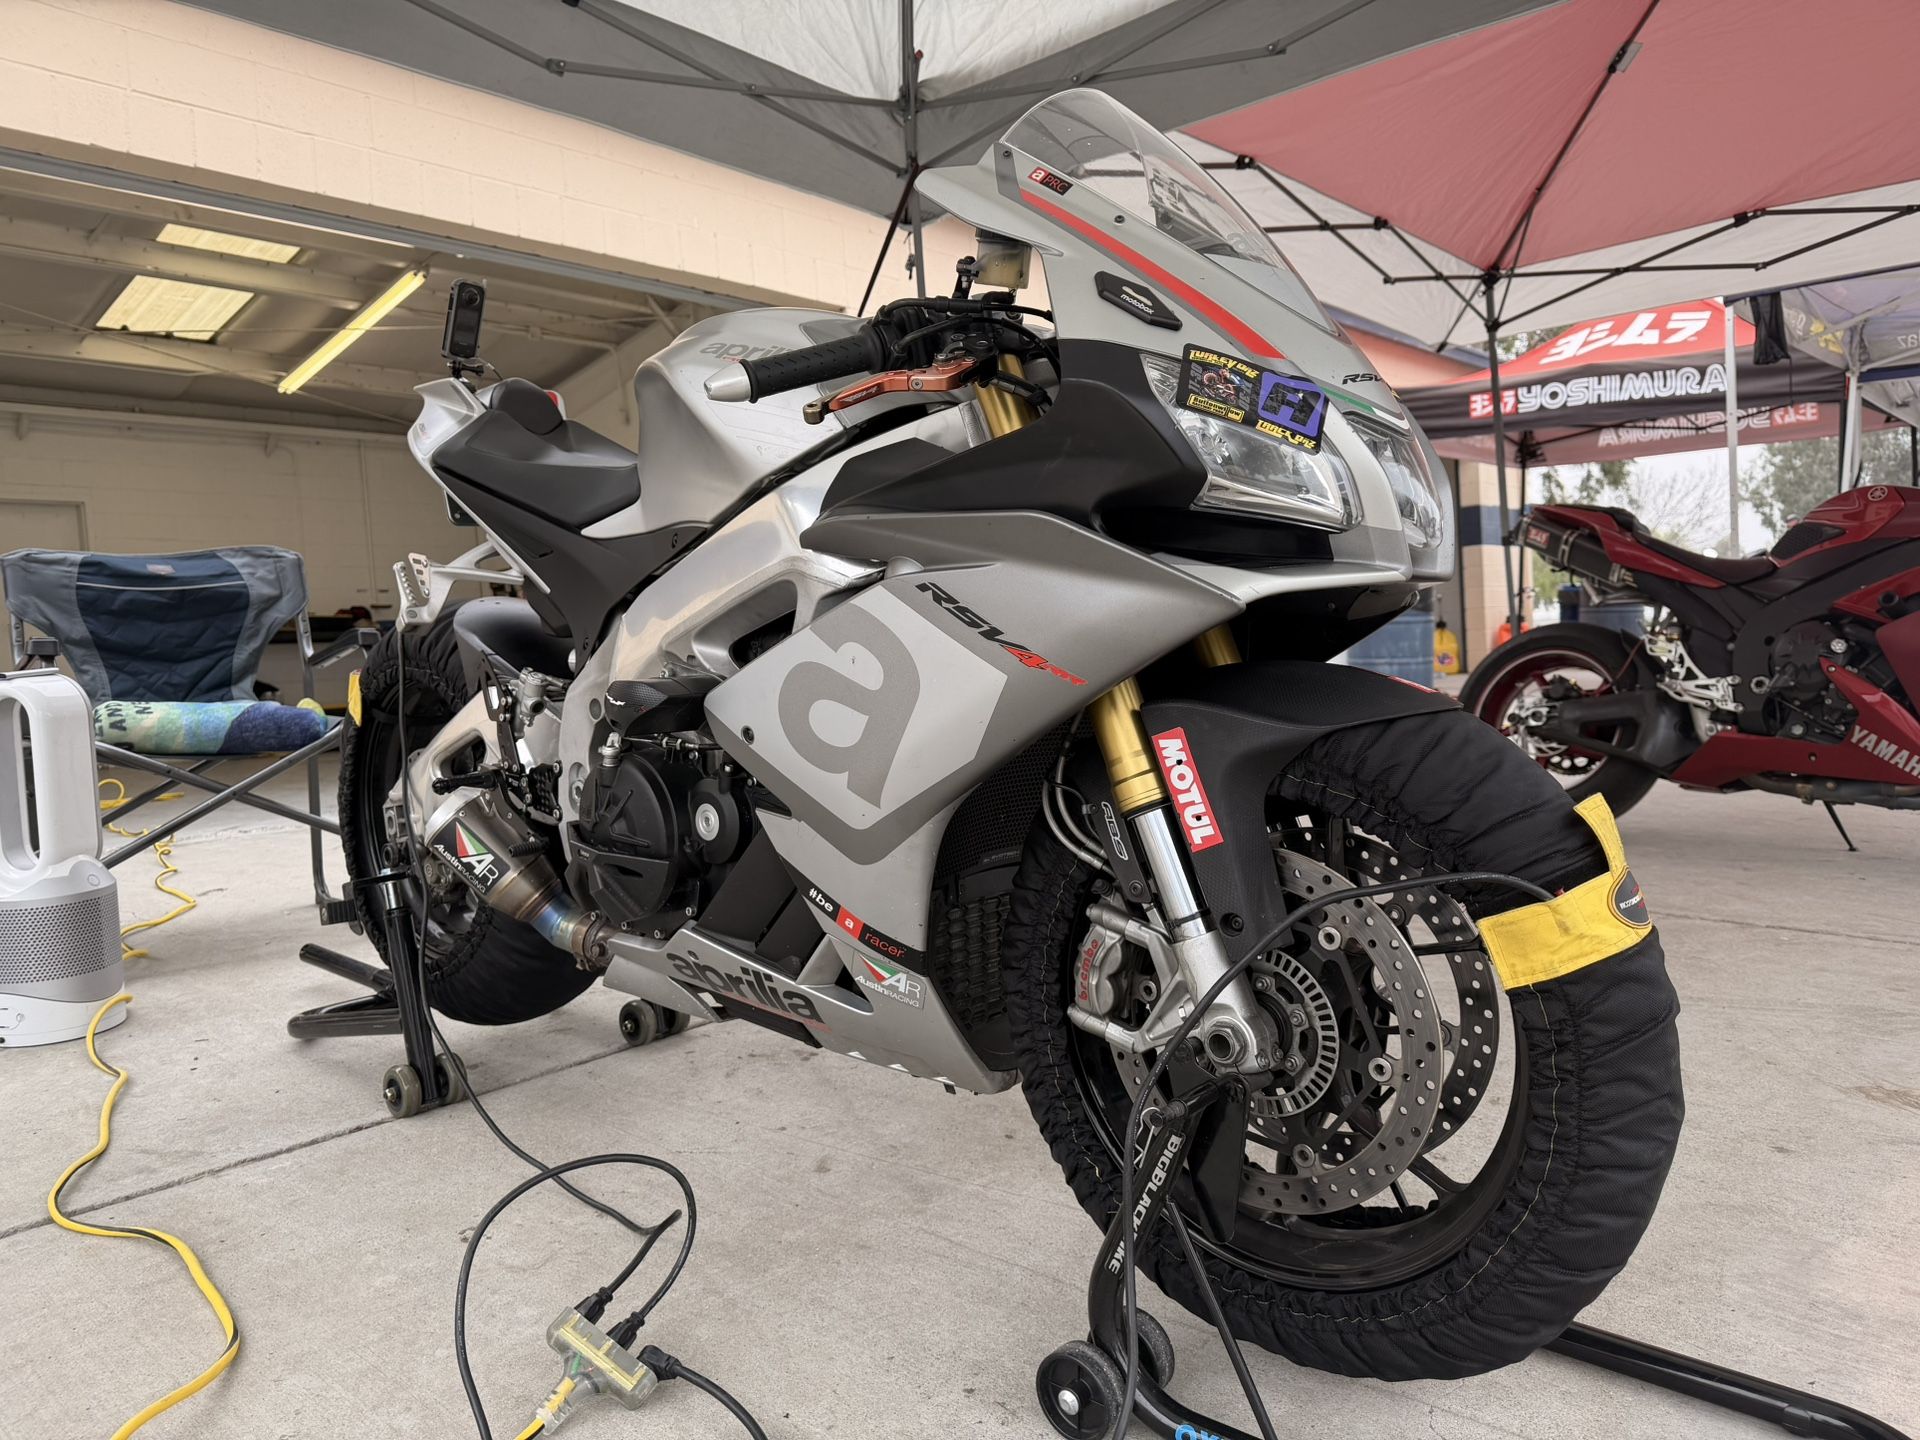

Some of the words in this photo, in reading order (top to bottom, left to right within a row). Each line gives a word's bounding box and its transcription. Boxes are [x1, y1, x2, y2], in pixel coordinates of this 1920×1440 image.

[1120, 293, 1154, 315] motobox
[1540, 310, 1712, 365] ヨシムラ
[1517, 363, 1729, 414] YOSHIMURA
[1158, 738, 1215, 844] MOTUL
[1101, 801, 1129, 861] ABS
[809, 888, 834, 913] #be
[844, 917, 855, 930] a
[666, 950, 826, 1025] aprilia
[1078, 939, 1099, 1001] brembo
